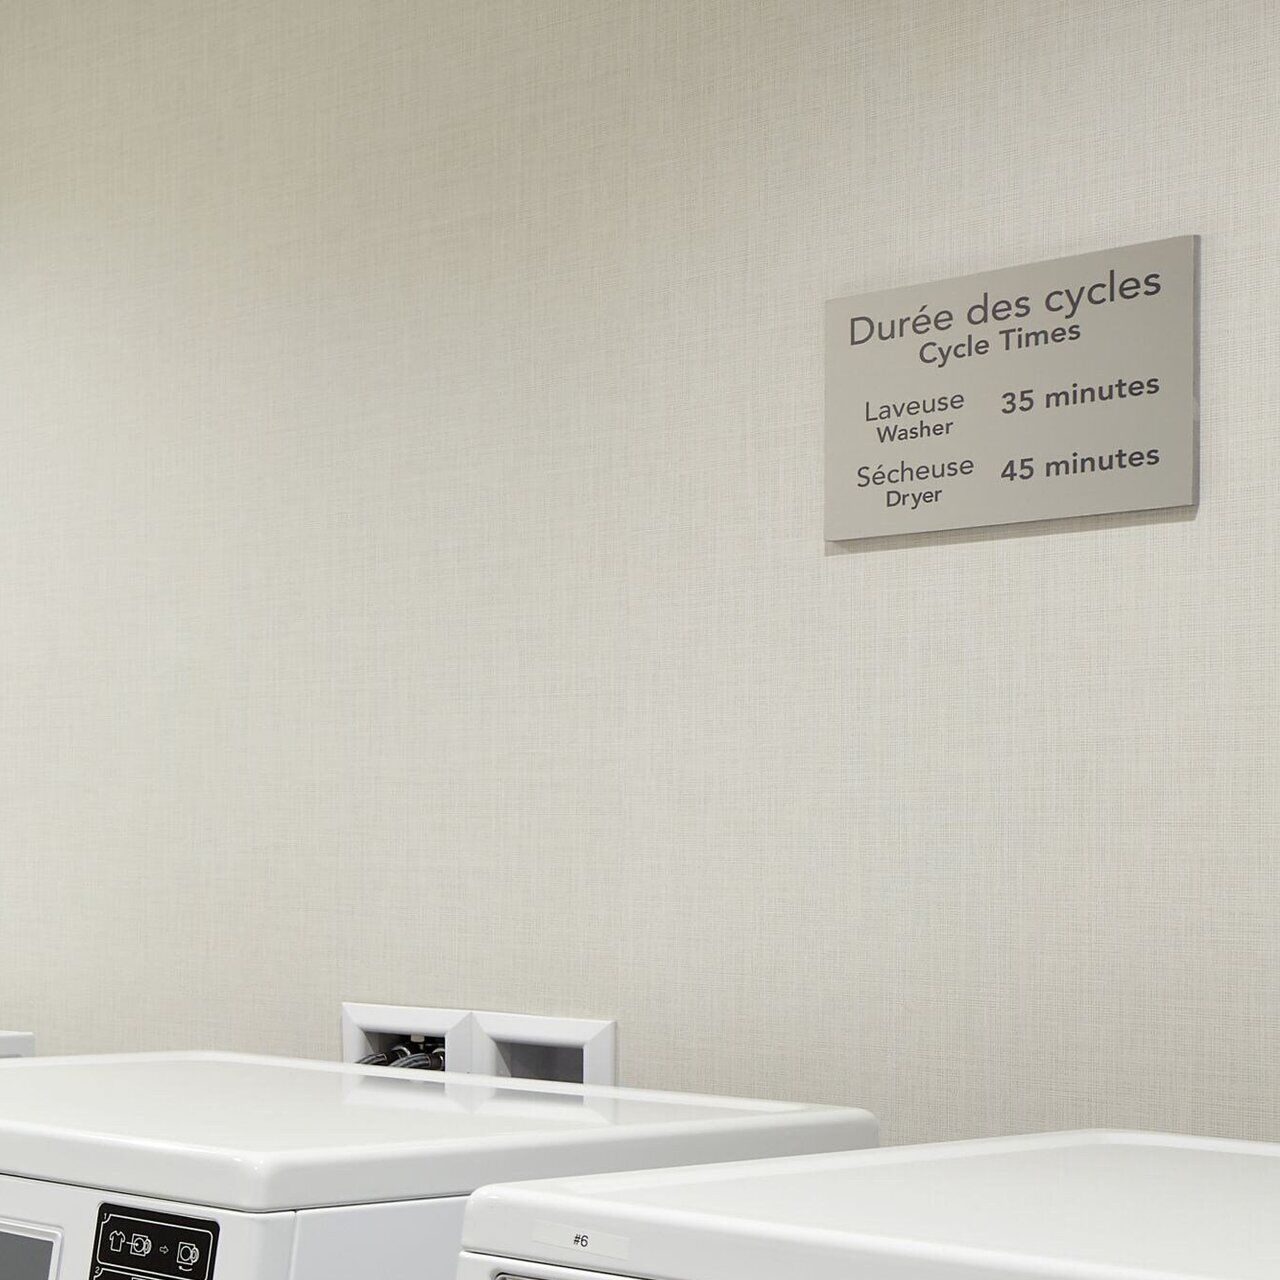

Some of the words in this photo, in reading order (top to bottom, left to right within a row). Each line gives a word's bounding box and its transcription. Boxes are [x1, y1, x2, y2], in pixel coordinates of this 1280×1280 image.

[850, 305, 954, 346] Durée
[966, 292, 1031, 325] des
[1044, 269, 1162, 319] cycles
[919, 334, 990, 368] Cycle
[999, 323, 1081, 351] Times
[865, 393, 965, 422] Laveuse
[1001, 390, 1034, 414] 35
[1044, 377, 1160, 409] minutes
[876, 419, 954, 443] Washer
[857, 459, 974, 488] Sécheuse
[1001, 458, 1034, 482] 45
[1045, 449, 1160, 477] minutes
[886, 489, 942, 509] Dryer
[573, 1234, 588, 1247] #6
[94, 1266, 100, 1274] 2
